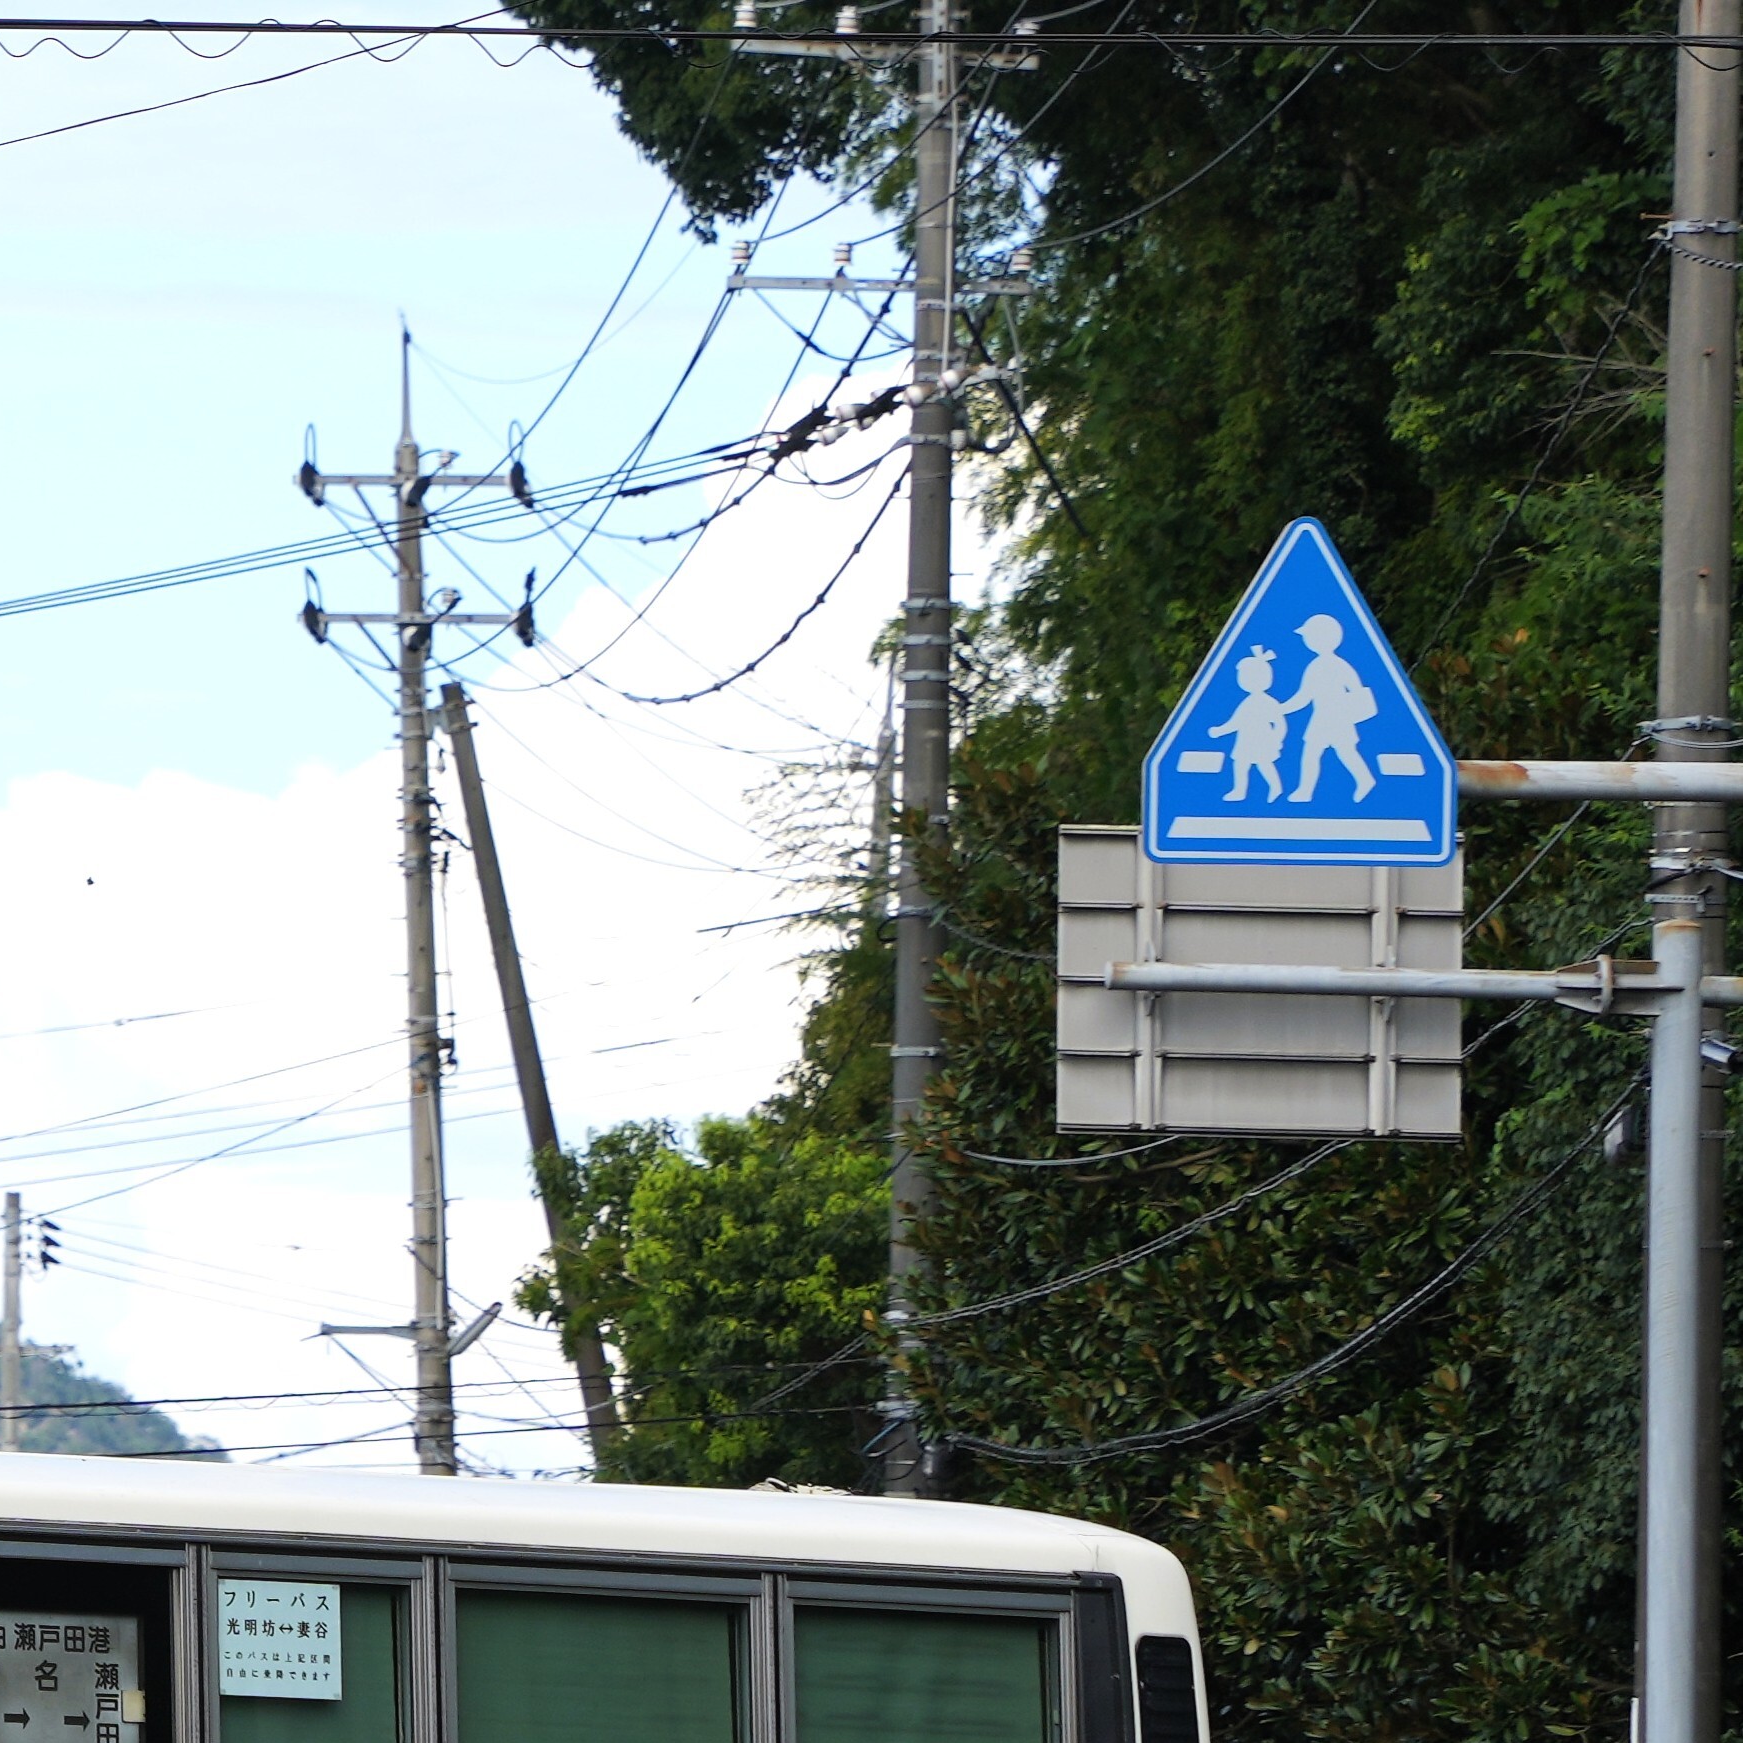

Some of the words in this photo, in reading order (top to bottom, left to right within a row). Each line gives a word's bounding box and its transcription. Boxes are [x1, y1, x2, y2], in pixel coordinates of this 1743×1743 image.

[224, 1590, 330, 1611] フリーバス
[226, 1617, 276, 1637] 光明坊
[14, 1622, 111, 1654] 瀬戸田港
